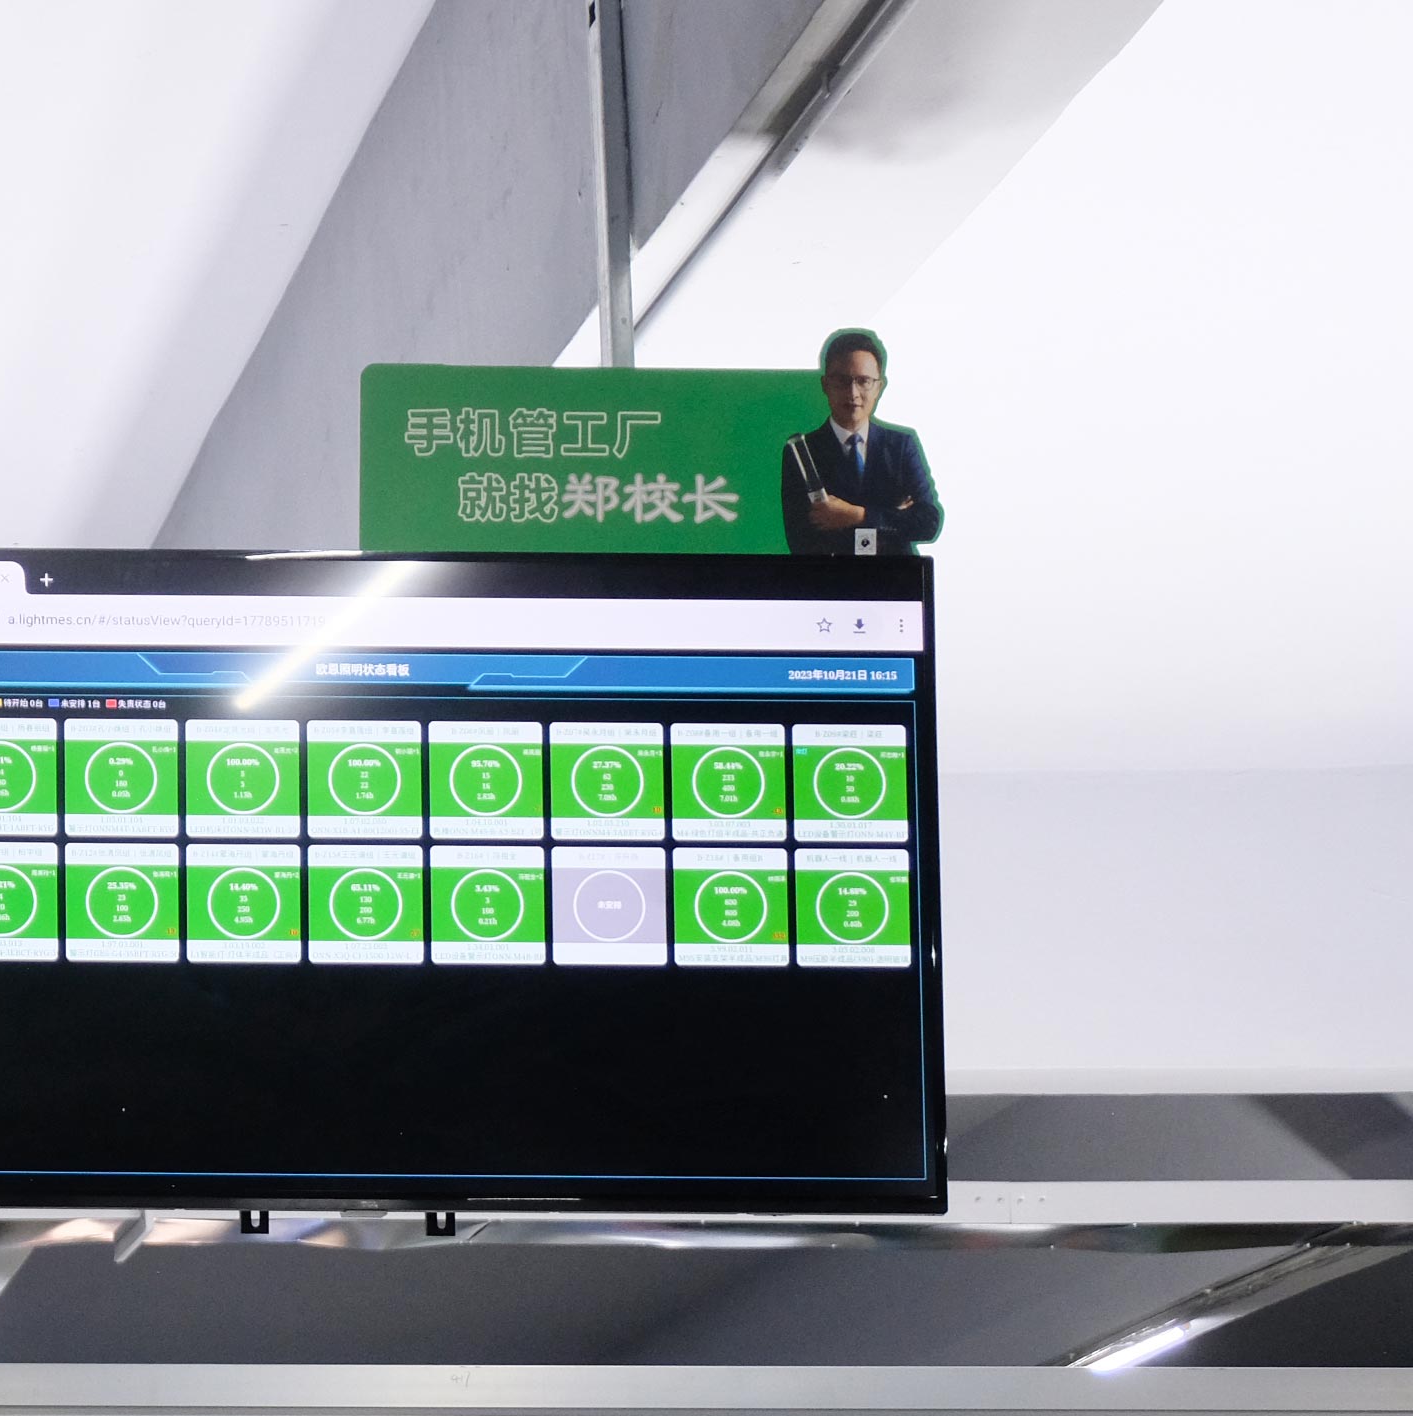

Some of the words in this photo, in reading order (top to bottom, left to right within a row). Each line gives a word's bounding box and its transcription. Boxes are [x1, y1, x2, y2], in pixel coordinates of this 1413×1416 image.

[404, 407, 661, 458] 手机管工厂
[458, 472, 739, 523] 就找郑校长
[315, 663, 410, 677] 欧恩照明状态看板
[788, 669, 867, 681] 2023年10月21日
[870, 670, 897, 680] 16:15
